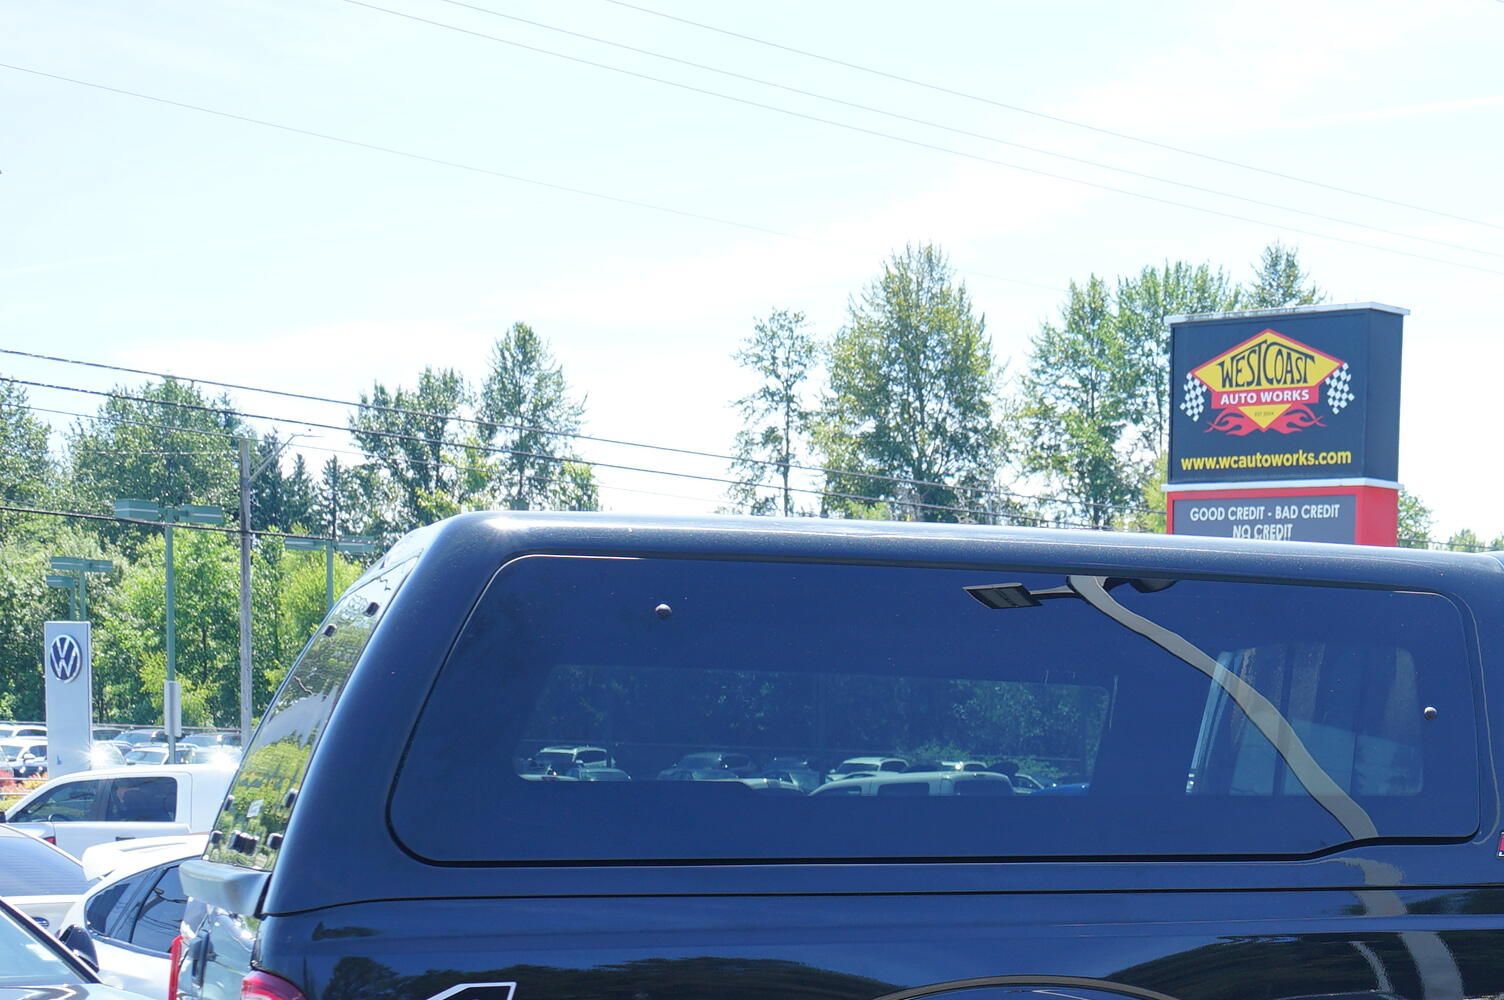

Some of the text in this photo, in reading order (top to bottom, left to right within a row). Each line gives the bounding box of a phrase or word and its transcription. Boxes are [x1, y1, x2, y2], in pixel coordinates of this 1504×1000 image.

[1220, 388, 1310, 405] AUTO WORKS
[1181, 449, 1352, 471] www.wcautoworks.com
[1190, 506, 1226, 521] GOOD
[1227, 506, 1265, 521] CREDIT
[1275, 505, 1299, 519] BAD
[1301, 503, 1340, 519] CREDIT
[1232, 523, 1294, 541] NO CREDIT
